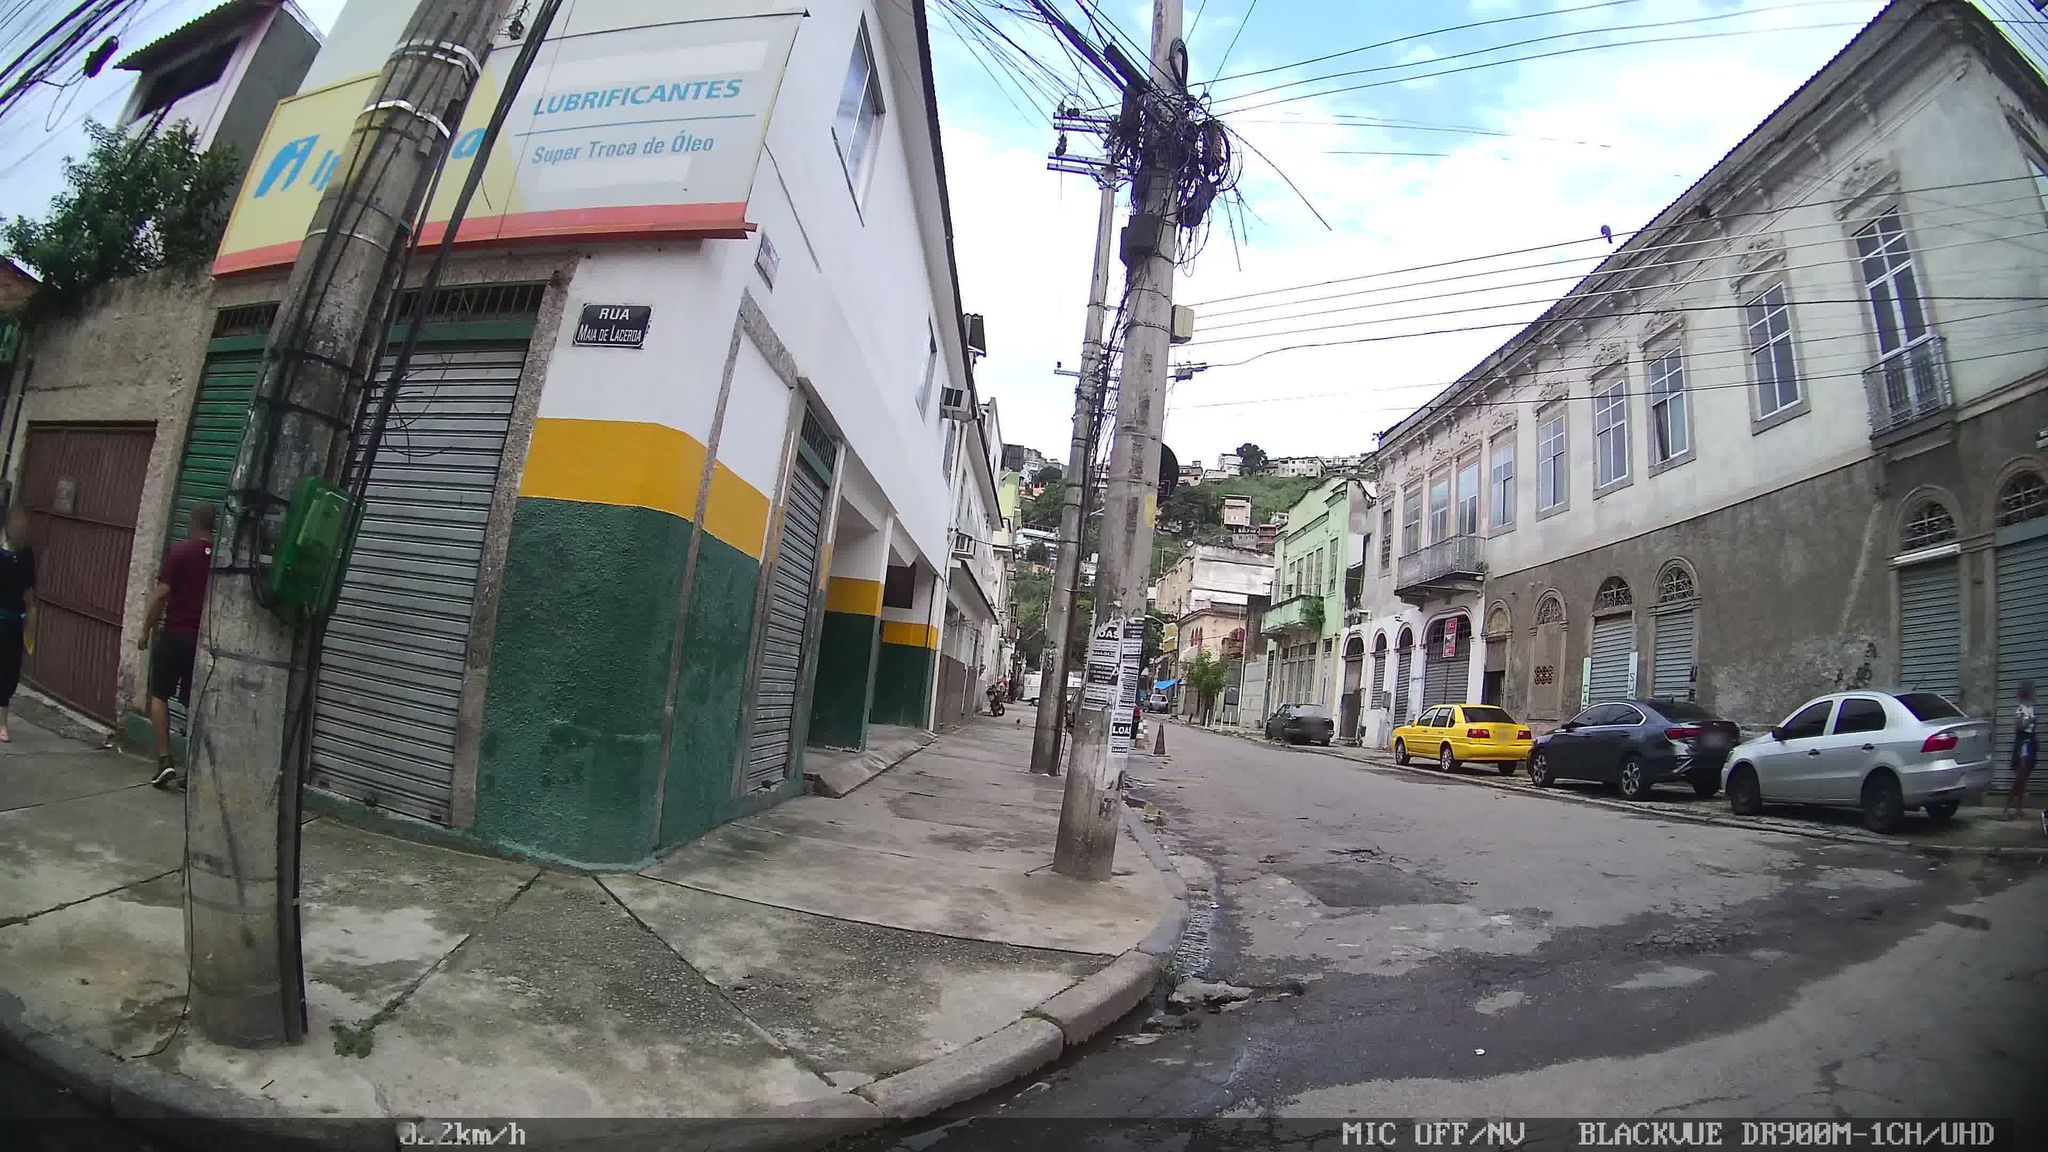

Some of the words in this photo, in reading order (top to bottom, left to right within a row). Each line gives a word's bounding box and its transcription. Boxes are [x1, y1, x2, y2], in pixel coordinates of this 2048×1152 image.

[533, 79, 743, 116] LUBRIFICANTES
[532, 145, 582, 165] Super
[588, 140, 638, 158] Troca
[643, 136, 665, 154] de
[671, 129, 715, 153] Óleo
[599, 308, 630, 320] RUA
